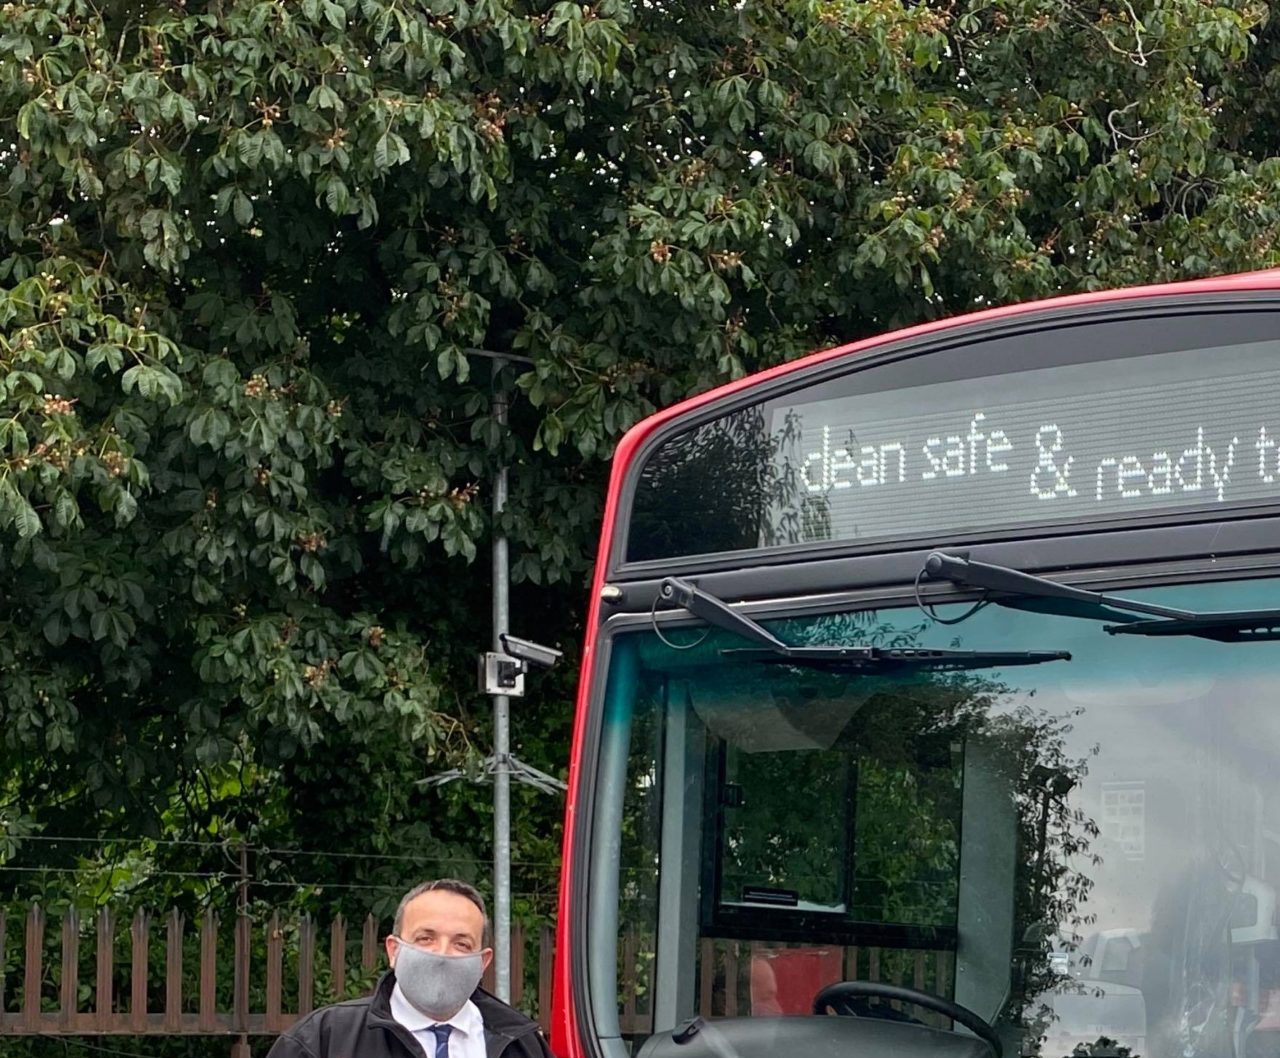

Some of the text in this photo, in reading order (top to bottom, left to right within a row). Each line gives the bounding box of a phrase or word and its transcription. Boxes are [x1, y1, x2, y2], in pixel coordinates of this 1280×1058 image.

[800, 424, 906, 492] clean
[921, 412, 1013, 481] safe
[1029, 423, 1078, 500] &
[1095, 425, 1240, 501] ready
